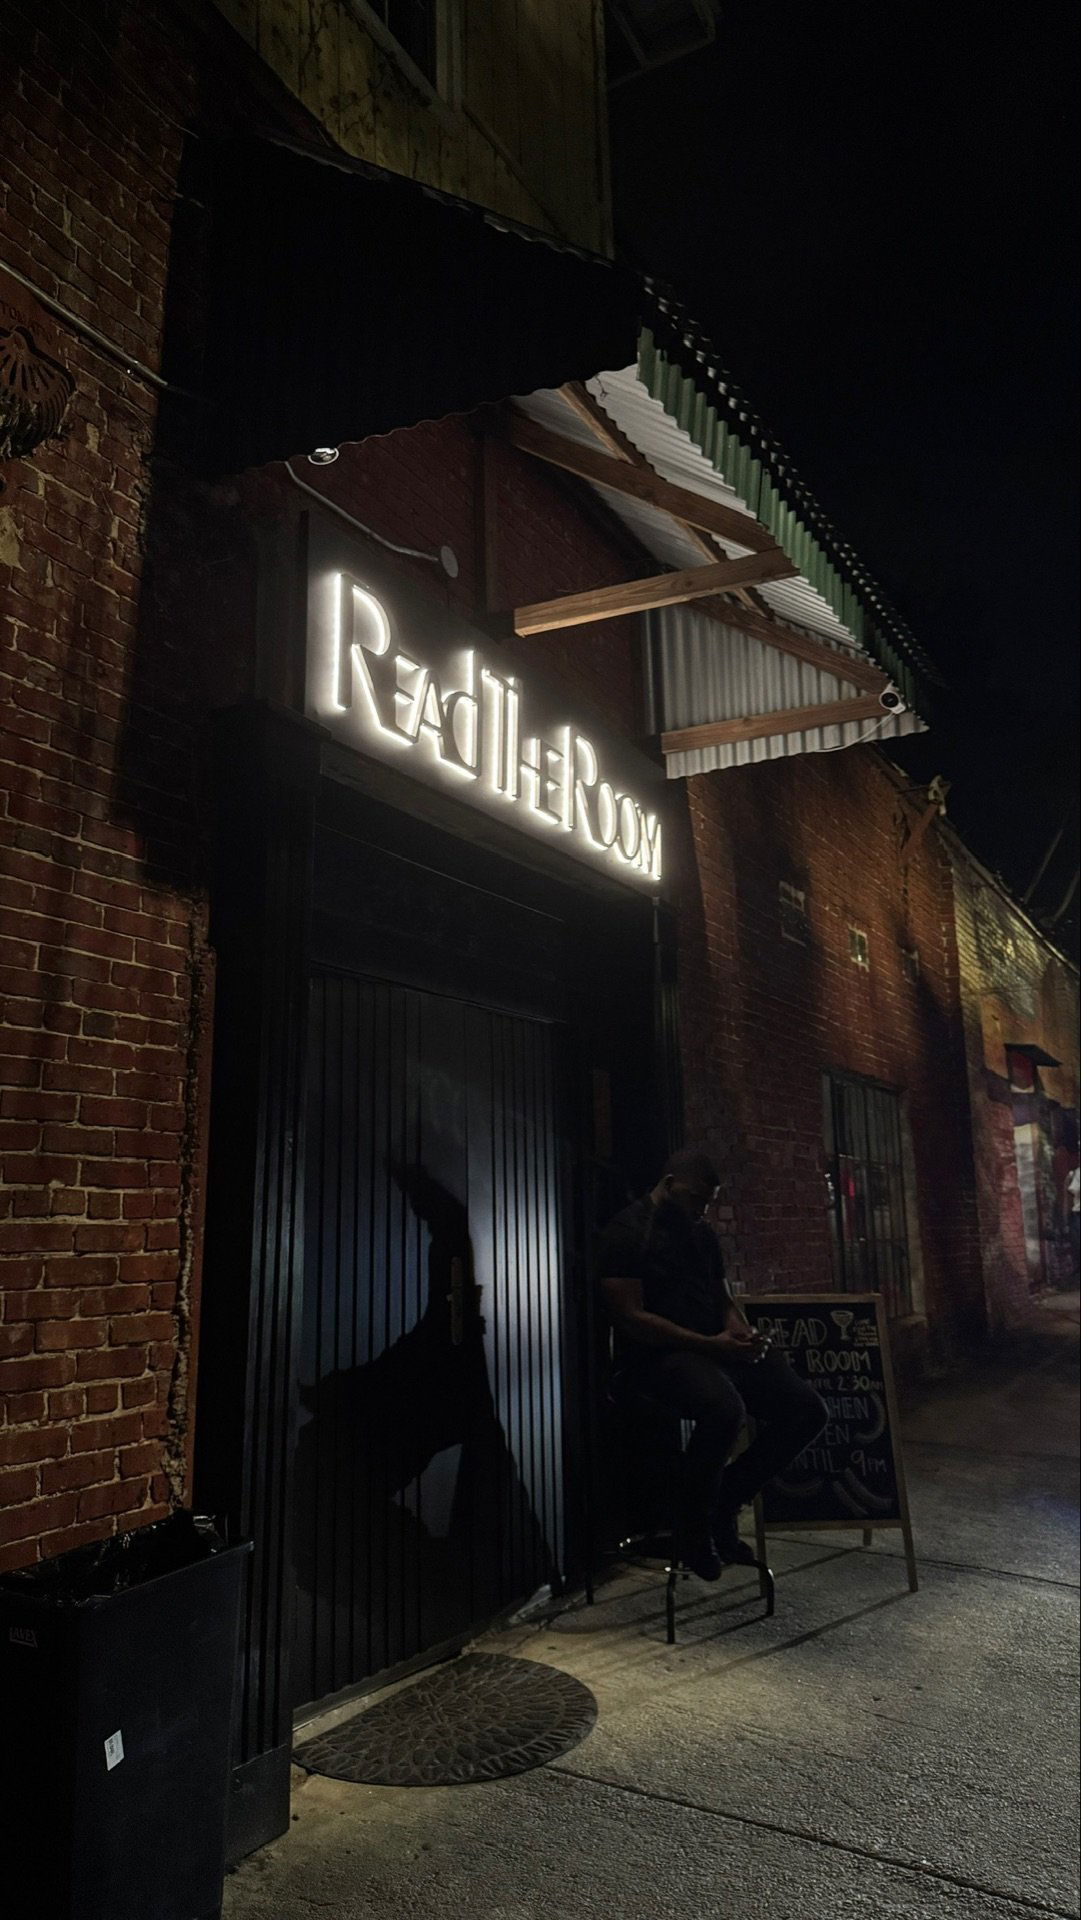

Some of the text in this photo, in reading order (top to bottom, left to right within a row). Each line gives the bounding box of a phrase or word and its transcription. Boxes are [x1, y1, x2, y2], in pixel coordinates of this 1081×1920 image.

[757, 1316, 827, 1348] READ
[805, 1349, 872, 1373] ROOM
[825, 1423, 850, 1446] EN
[788, 1448, 841, 1473] NTIL
